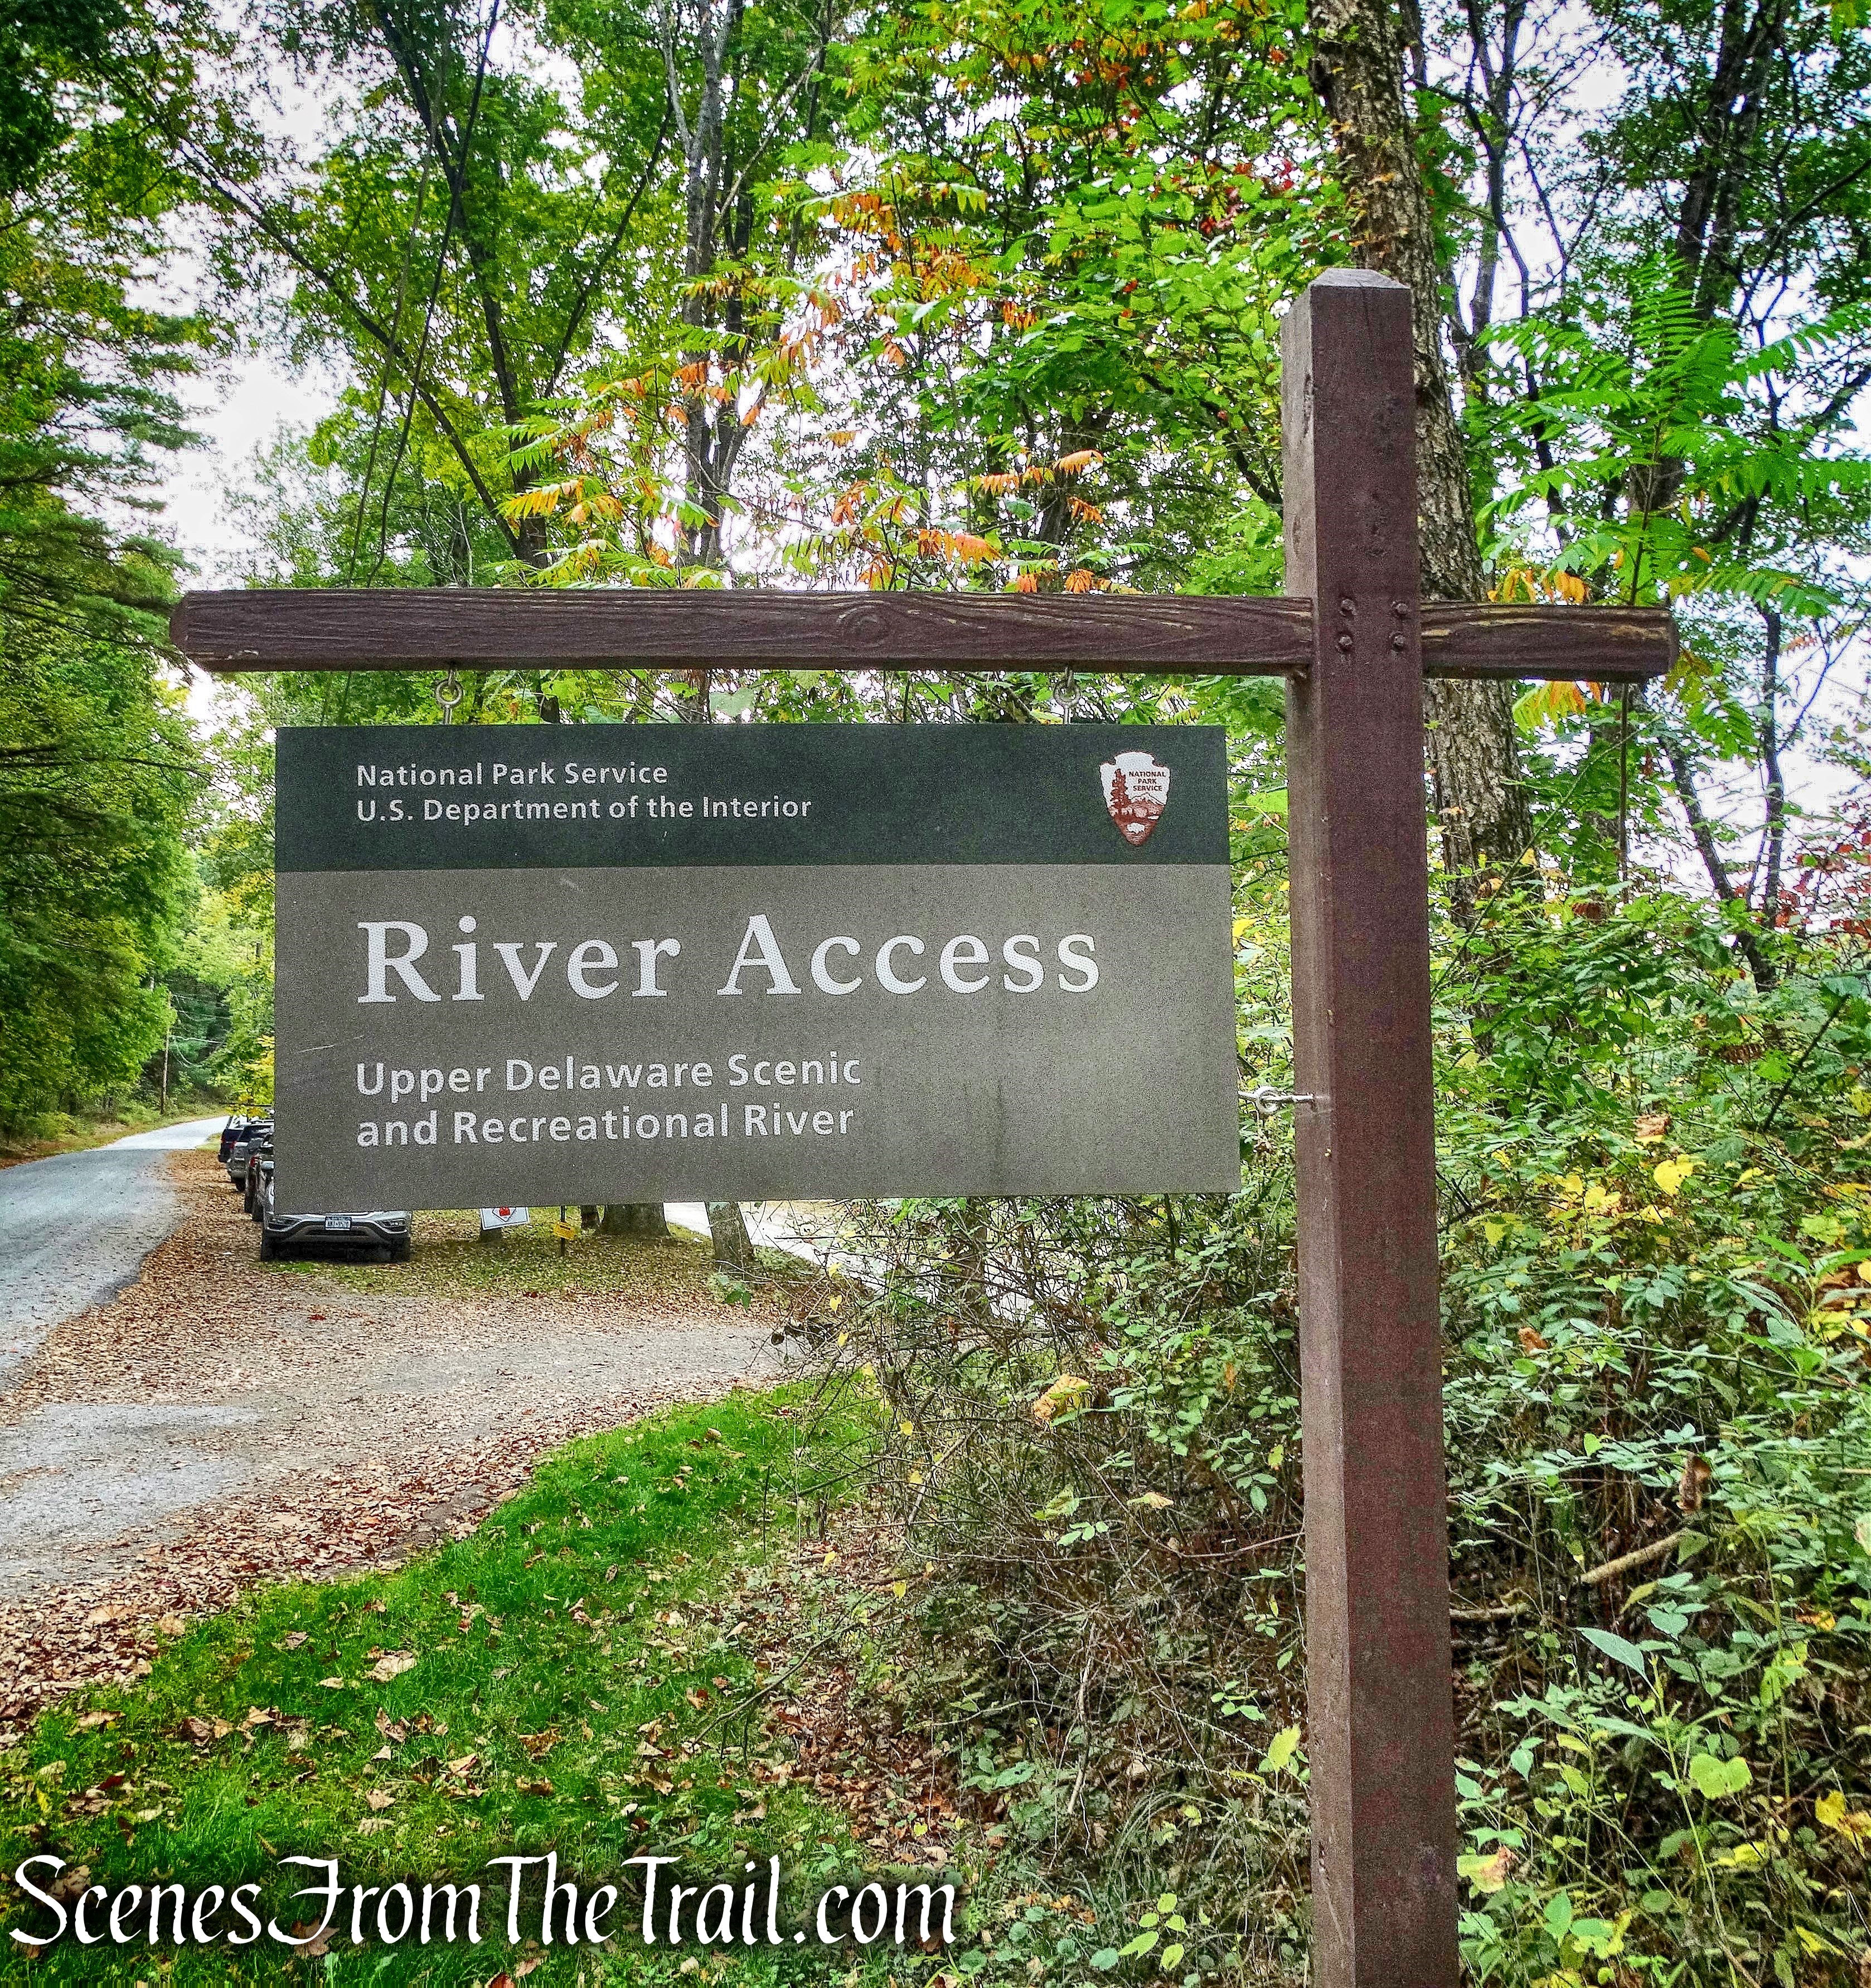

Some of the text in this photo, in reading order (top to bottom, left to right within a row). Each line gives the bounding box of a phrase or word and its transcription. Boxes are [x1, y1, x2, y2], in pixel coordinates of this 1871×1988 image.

[357, 762, 667, 786] National Park Service
[357, 795, 812, 826] U.S. Department of the Interior
[357, 913, 1100, 1004] River Access
[357, 1052, 861, 1104] Upper Delaware Scenic
[357, 1102, 854, 1147] and Recreational River
